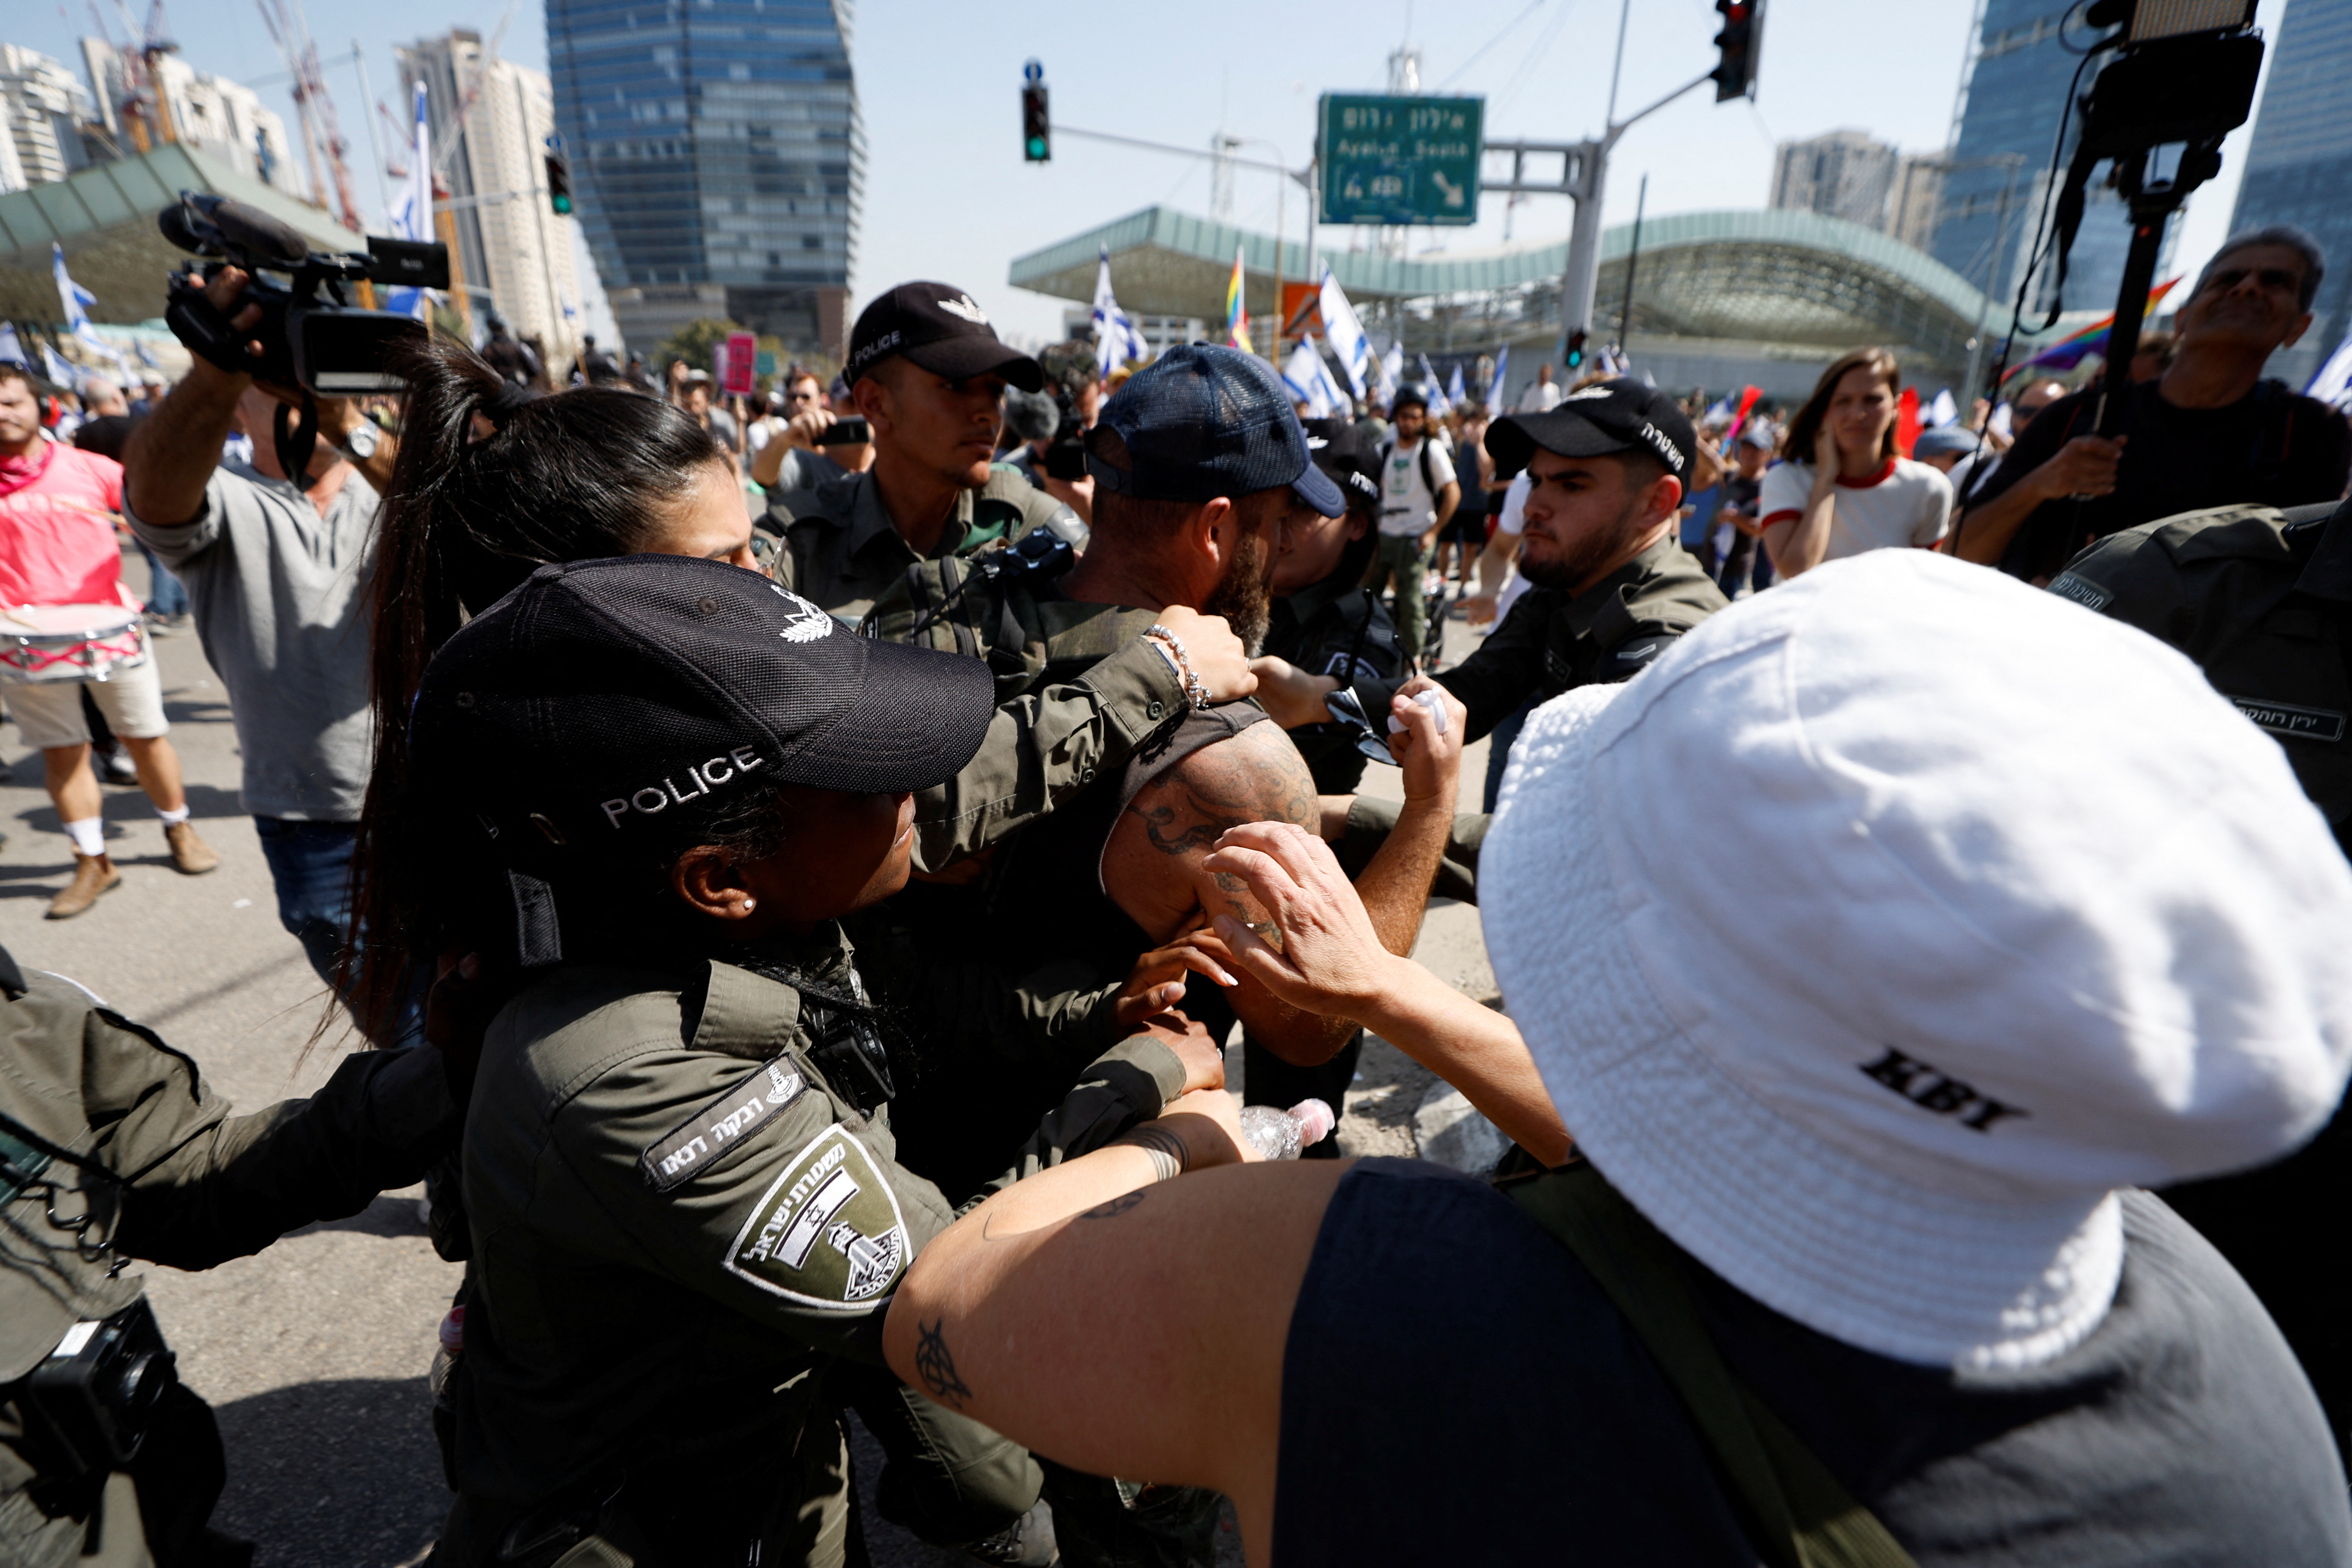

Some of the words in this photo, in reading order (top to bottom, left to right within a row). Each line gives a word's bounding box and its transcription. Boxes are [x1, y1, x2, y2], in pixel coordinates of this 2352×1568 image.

[855, 330, 901, 364] POLICE
[1640, 422, 1685, 471] משטרה
[600, 745, 763, 829] POLICE
[710, 1097, 764, 1143] רבקה
[1857, 1045, 2032, 1133] KBY
[789, 1143, 846, 1205] משטרת
[741, 1197, 793, 1262] ישראל
